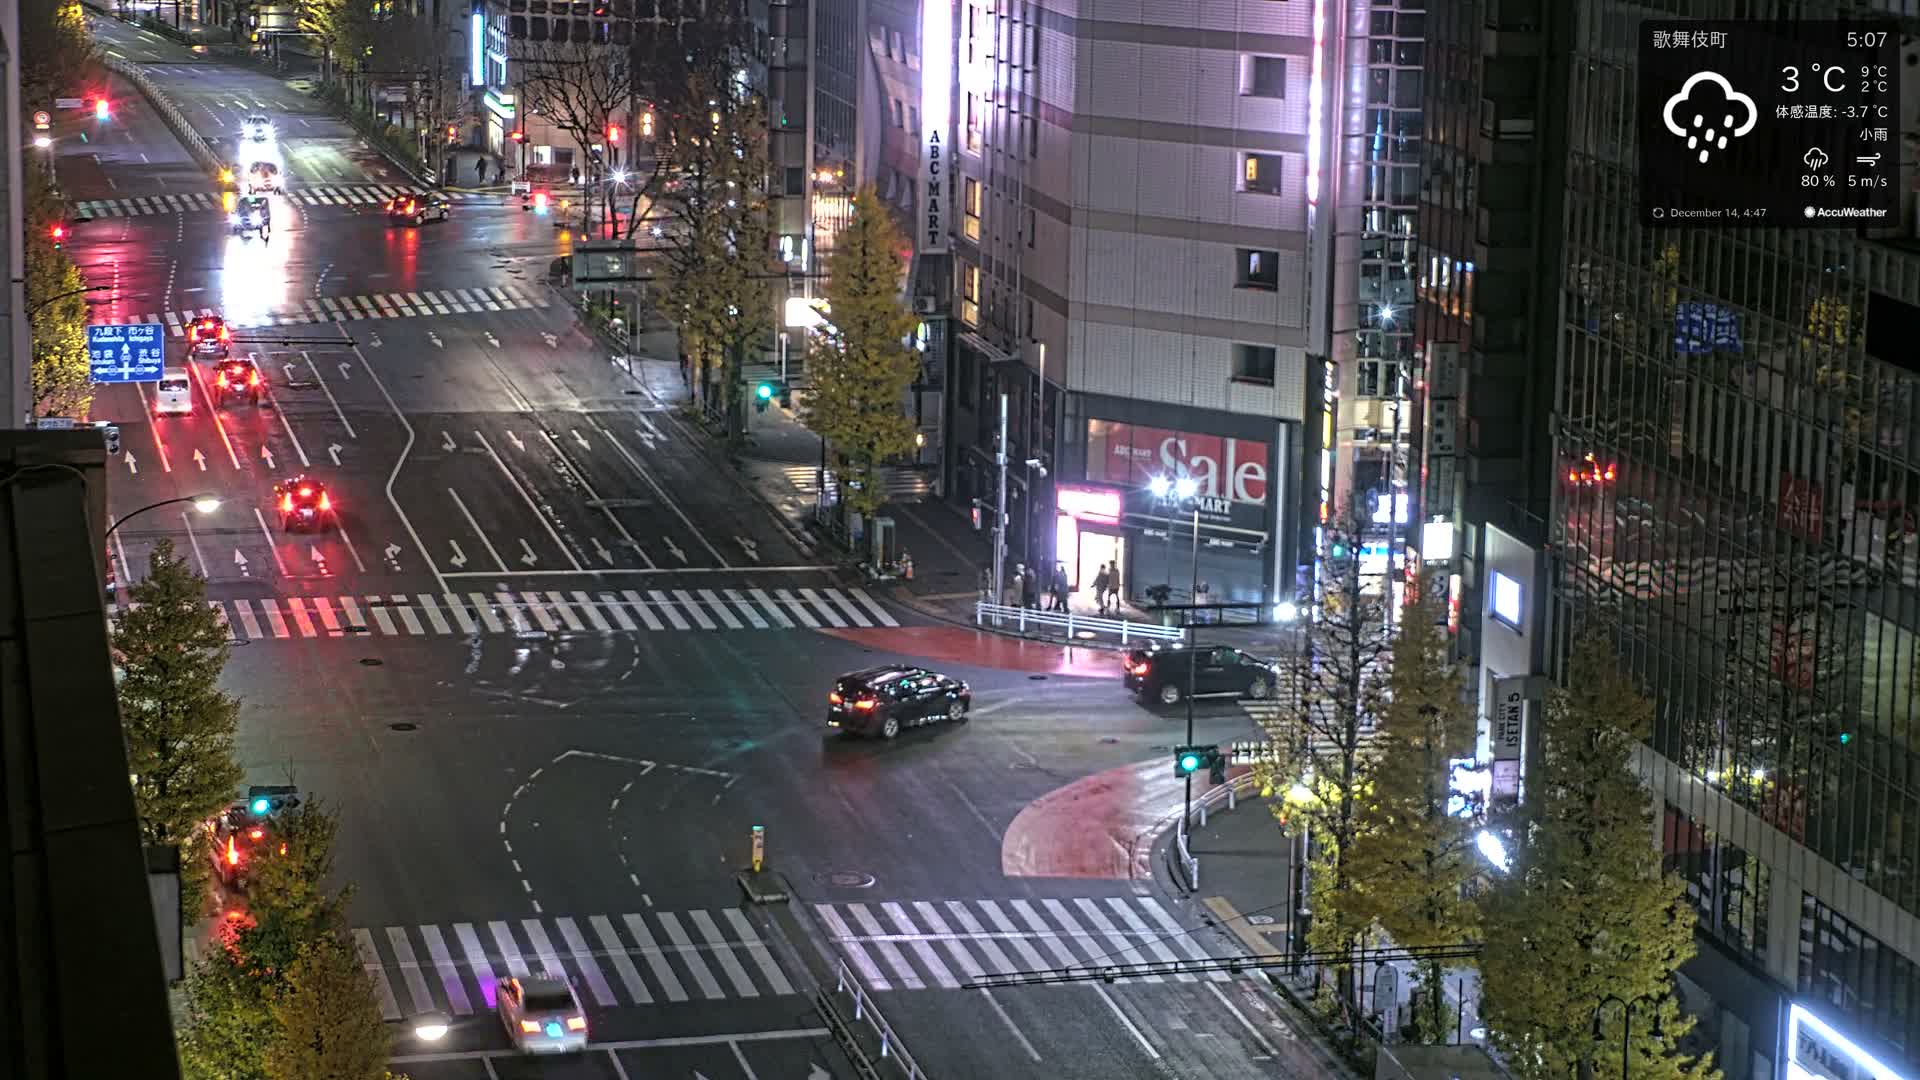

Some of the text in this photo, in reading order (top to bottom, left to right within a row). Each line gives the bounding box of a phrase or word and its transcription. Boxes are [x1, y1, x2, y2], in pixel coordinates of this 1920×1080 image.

[95, 327, 122, 336] 九段下
[1159, 437, 1267, 505] Sale
[1507, 692, 1520, 747] ISETAN 5
